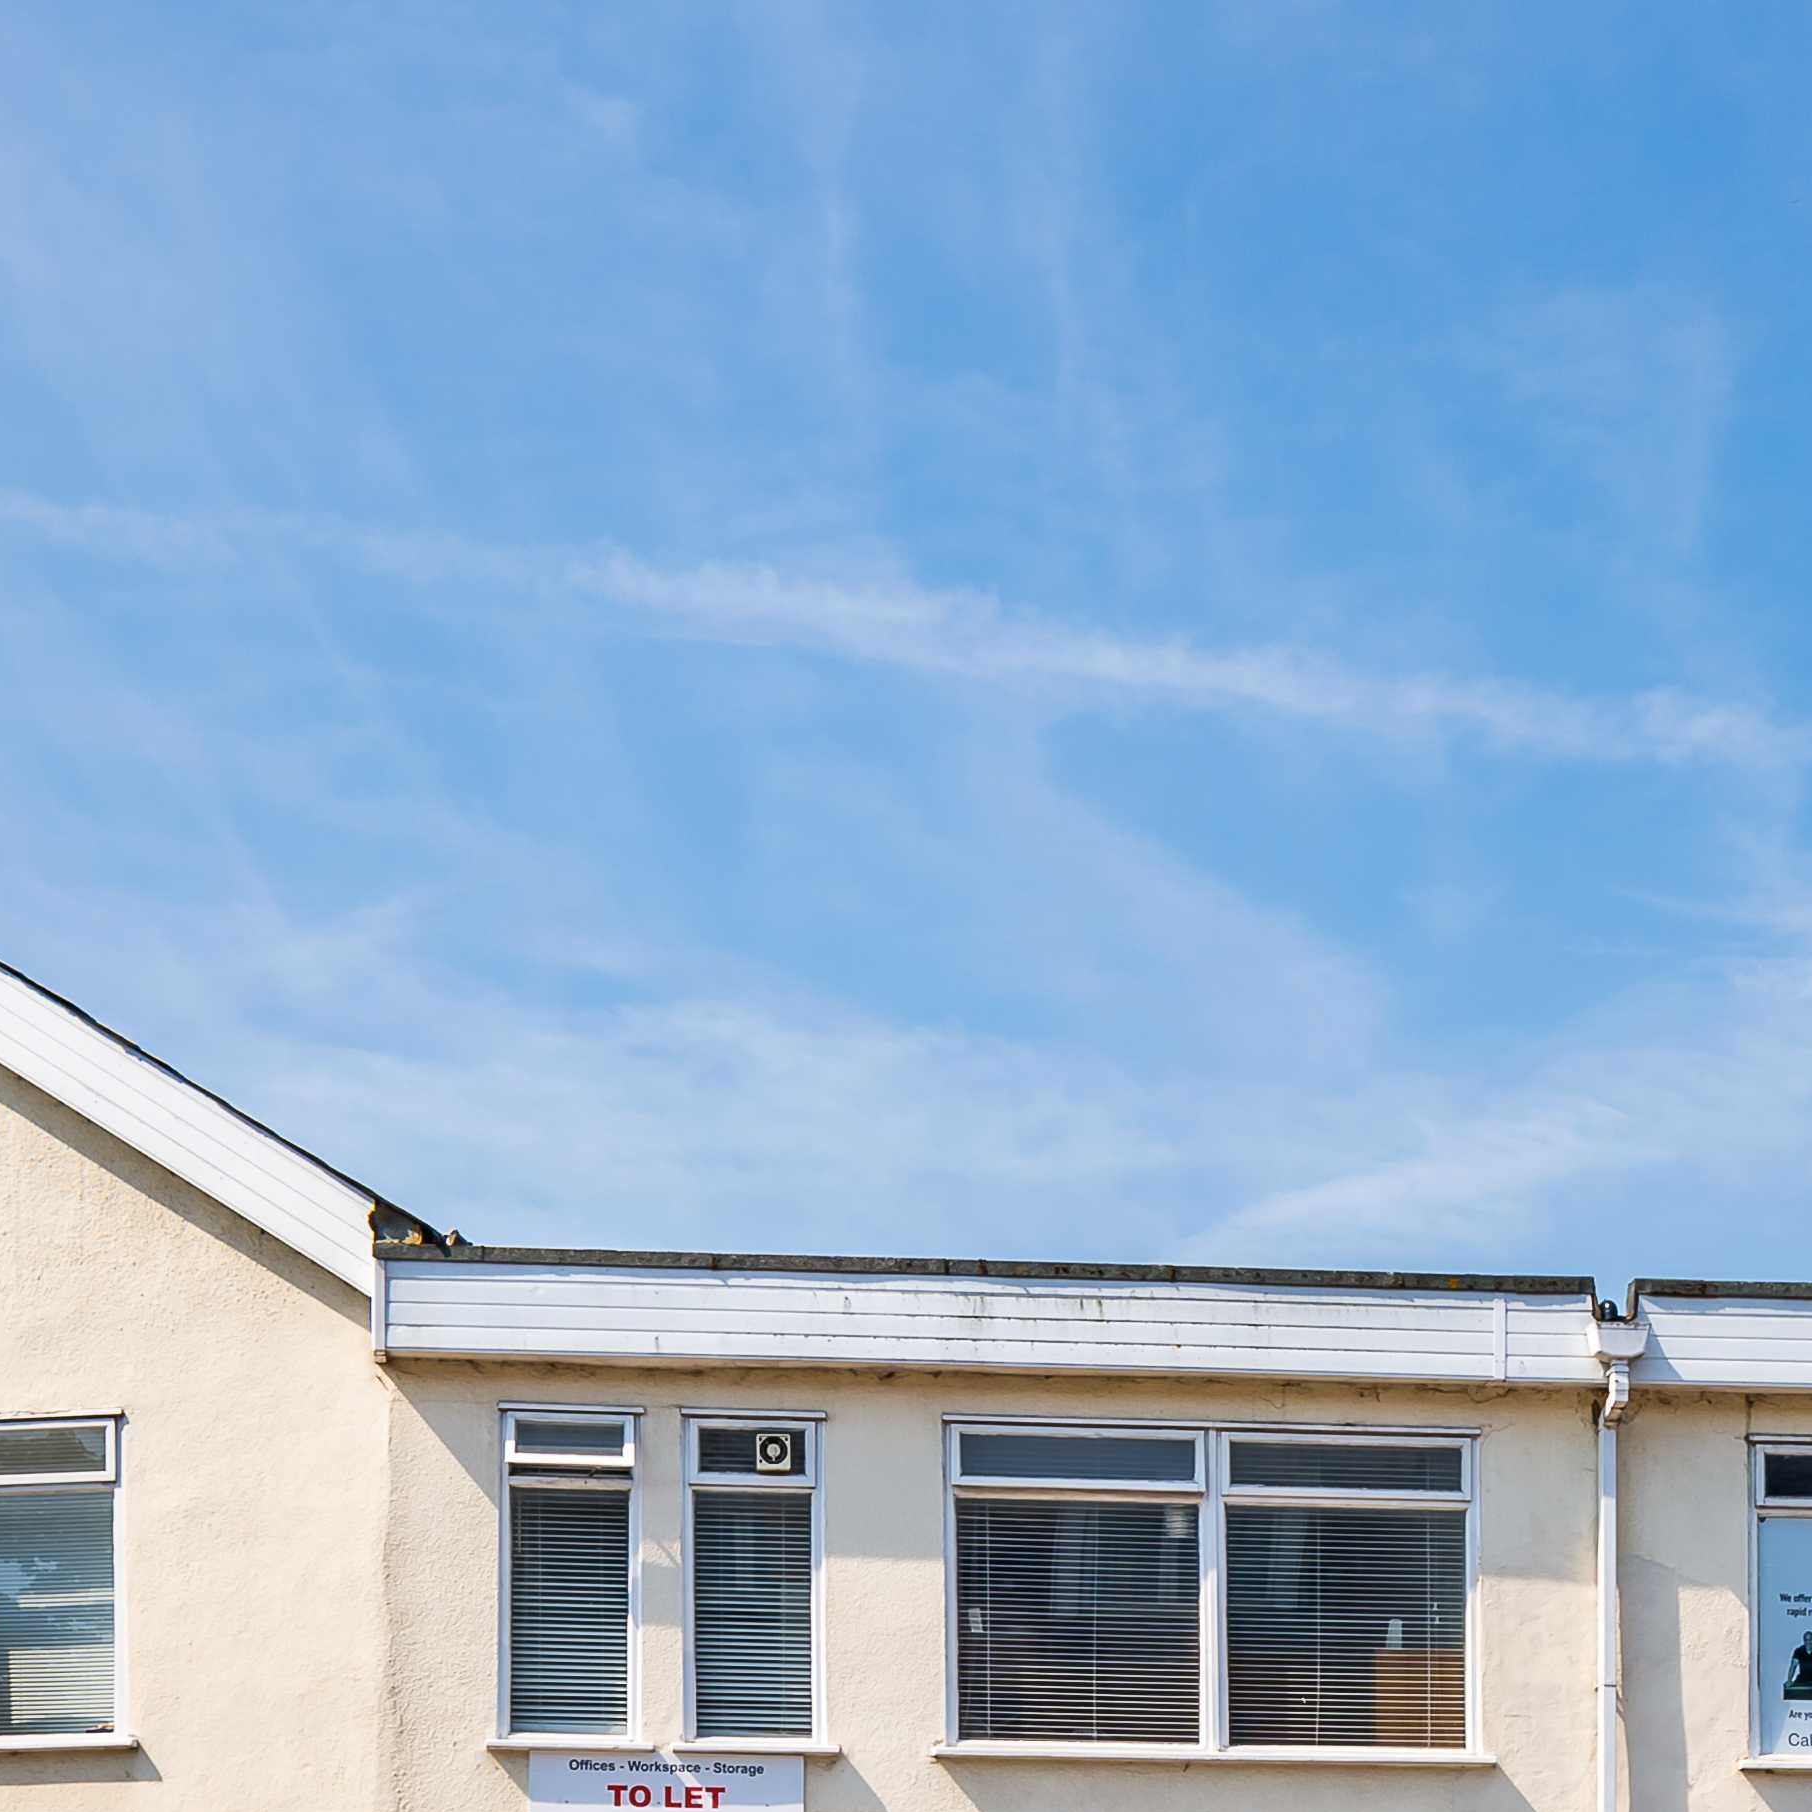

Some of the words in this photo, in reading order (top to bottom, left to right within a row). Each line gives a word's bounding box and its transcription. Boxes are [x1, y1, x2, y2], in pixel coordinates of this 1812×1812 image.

[1780, 1594, 1792, 1602] We
[1794, 1594, 1812, 1603] offer
[1787, 1608, 1806, 1617] rapid
[569, 1760, 615, 1771] Offices
[628, 1760, 700, 1774] Workspace
[714, 1763, 764, 1776] Storage
[608, 1785, 651, 1807] TO
[665, 1786, 725, 1808] LET
